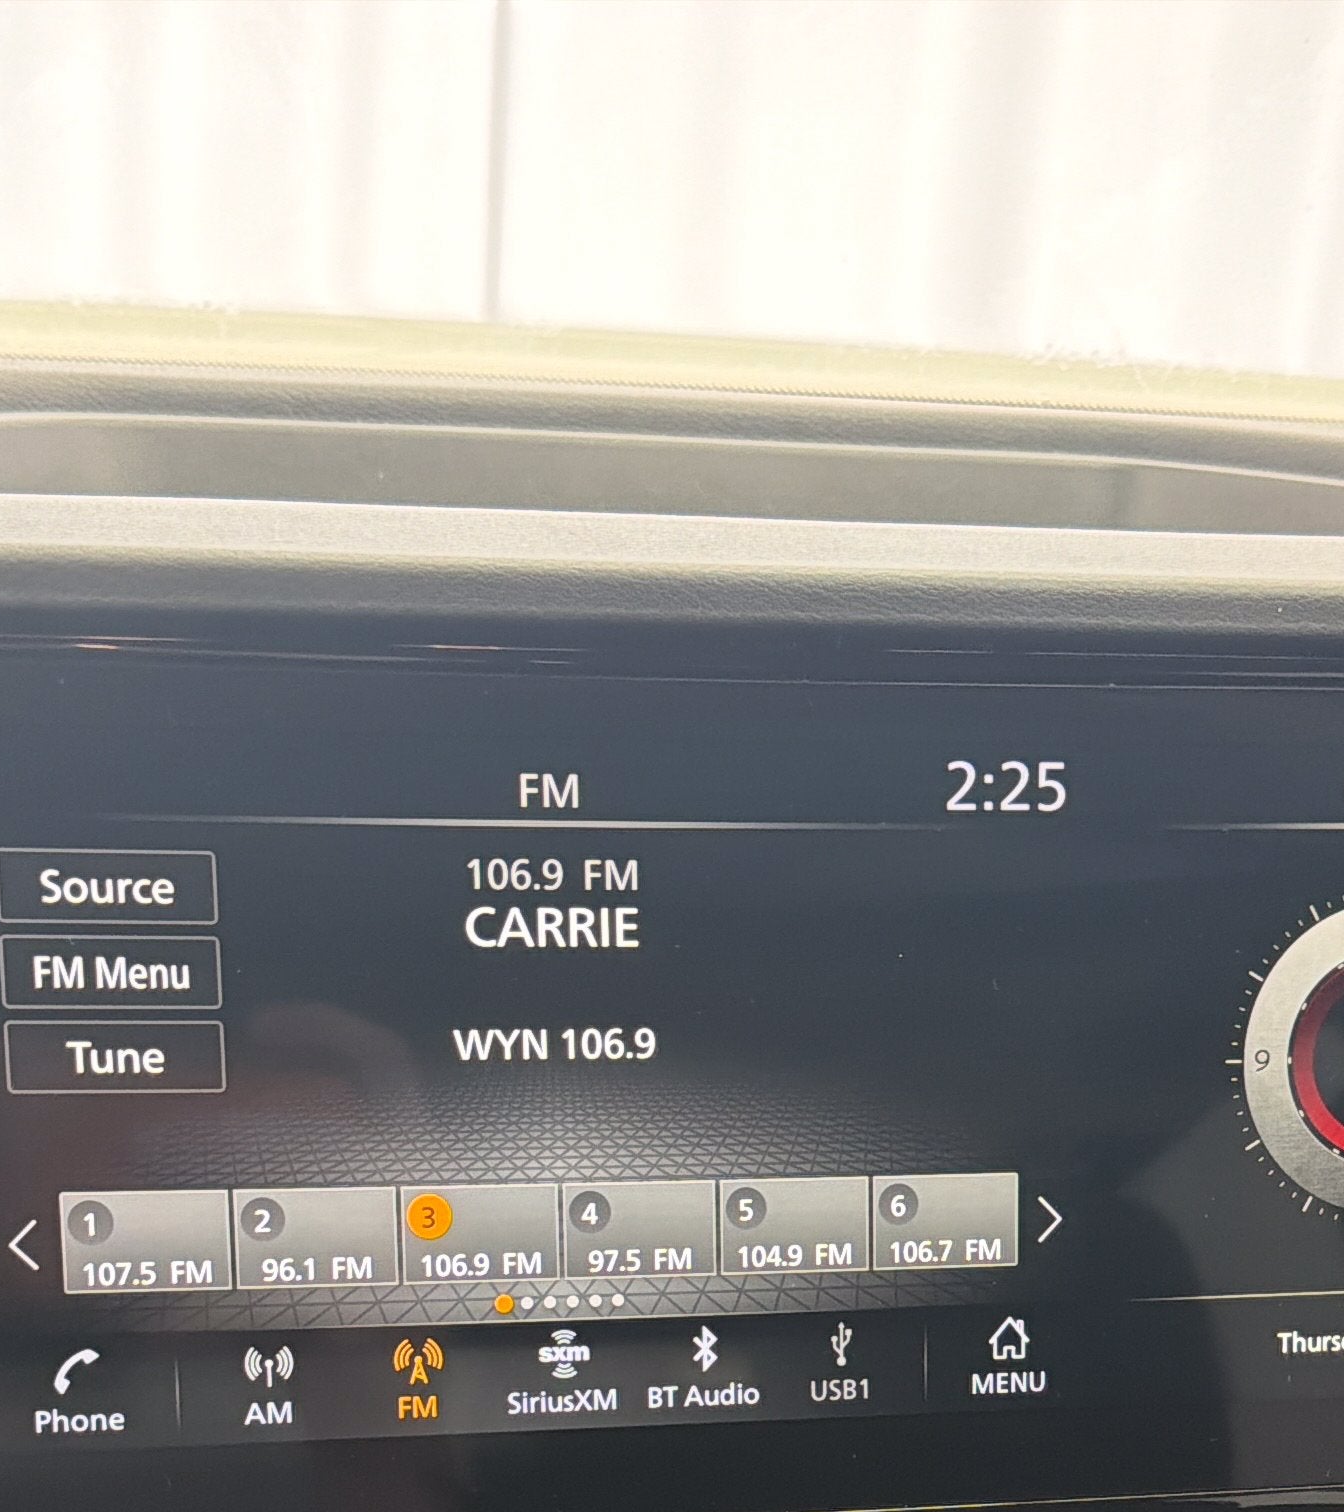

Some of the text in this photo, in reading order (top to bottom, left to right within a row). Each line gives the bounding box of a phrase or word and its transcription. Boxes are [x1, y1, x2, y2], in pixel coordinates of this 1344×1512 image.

[518, 773, 579, 808] FM
[945, 760, 1067, 813] 2:25
[39, 868, 176, 907] Source
[466, 858, 640, 892] 106.9 FM
[464, 906, 641, 950] CARRIE
[32, 955, 191, 991] FM Menu
[453, 1027, 657, 1062] WYN 106.9
[66, 1040, 166, 1076] Tune
[1254, 1049, 1271, 1073] 9
[421, 1206, 436, 1230] 3
[581, 1202, 598, 1226] 4
[738, 1199, 754, 1223] 5
[889, 1194, 907, 1218] 6
[82, 1212, 97, 1238] 1
[254, 1210, 272, 1235] 2
[587, 1247, 693, 1274] 97.5 FM
[737, 1242, 853, 1268] 104.9 FM
[889, 1238, 1002, 1264] 106.7 FM
[83, 1260, 213, 1288] 107.5 FM
[261, 1255, 373, 1283] 96.1 FM
[420, 1251, 543, 1278] 106.9 FM
[538, 1342, 591, 1364] sxm
[647, 1382, 761, 1409] BT Audio
[810, 1378, 870, 1403] USB1
[970, 1370, 1048, 1396] MENU
[244, 1401, 293, 1426] AM
[397, 1395, 439, 1420] FM
[507, 1387, 618, 1415] SiriusXM
[34, 1410, 126, 1435] Phone
